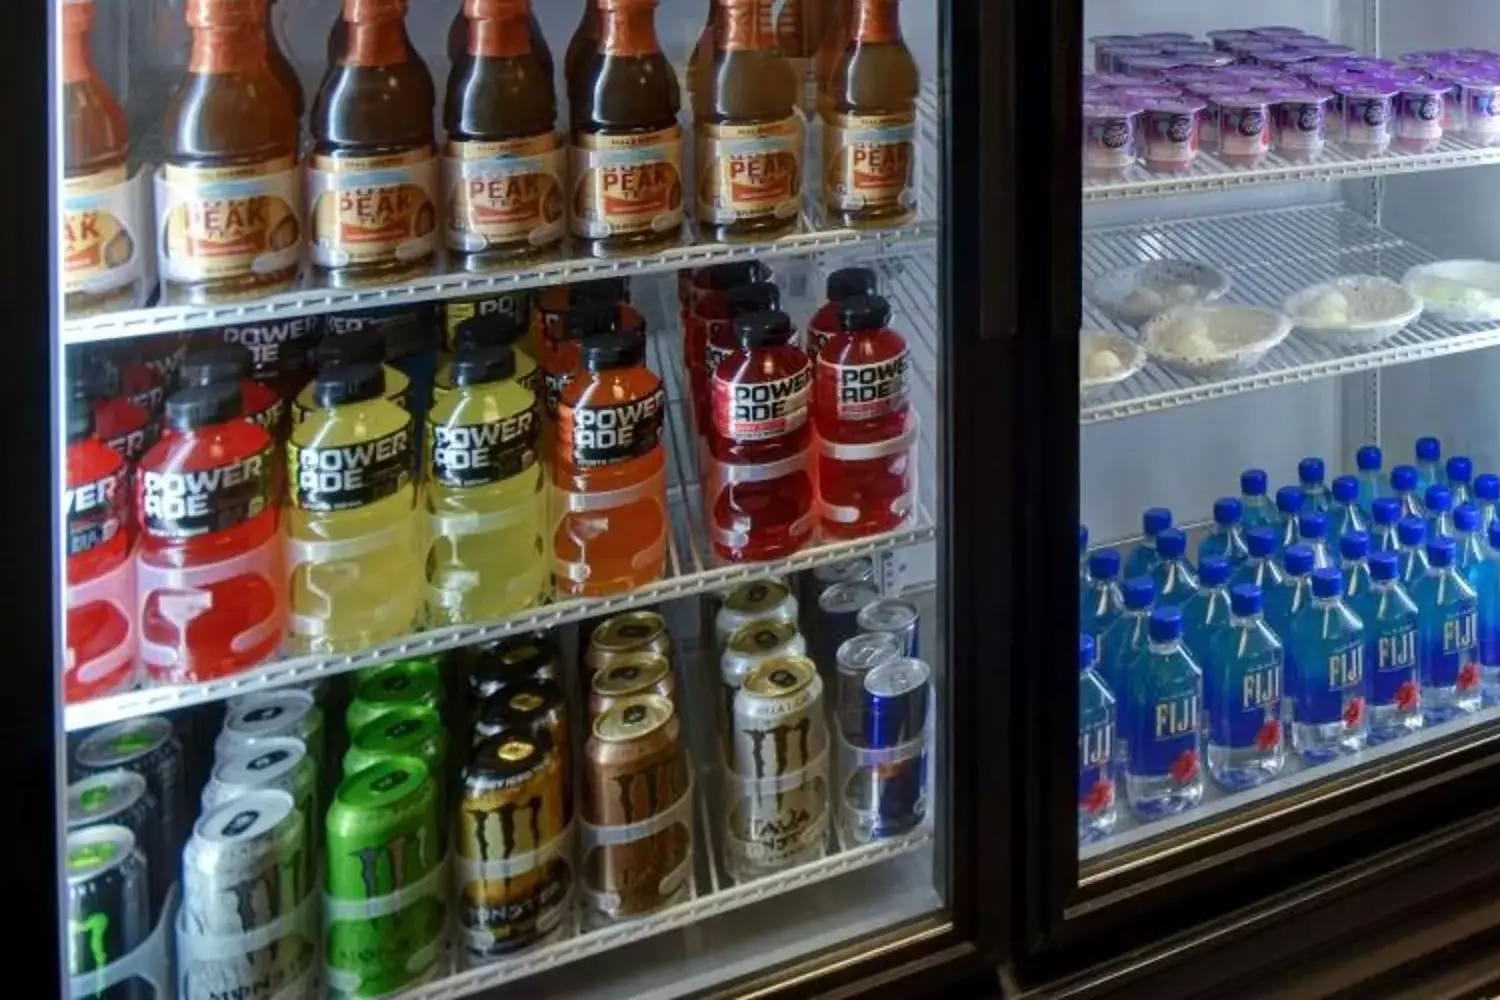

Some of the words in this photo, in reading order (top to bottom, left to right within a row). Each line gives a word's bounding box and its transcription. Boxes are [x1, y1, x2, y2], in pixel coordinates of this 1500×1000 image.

[730, 154, 789, 179] PEAK
[470, 176, 539, 200] PEAK
[603, 171, 668, 192] PEAK
[841, 384, 891, 407] ADE
[734, 402, 786, 423] ADE
[434, 411, 534, 450] POWER
[575, 427, 635, 451] ADE
[300, 431, 408, 473] POWER
[435, 447, 491, 470] ADE
[142, 456, 264, 498] POWER
[300, 468, 364, 492] ADE
[143, 492, 210, 521] ADE
[1443, 612, 1477, 650] FIJI
[1378, 630, 1415, 669] FIJI
[1329, 645, 1364, 687] FIJI
[1242, 671, 1281, 709] FIJI
[1155, 696, 1198, 738] FIJI
